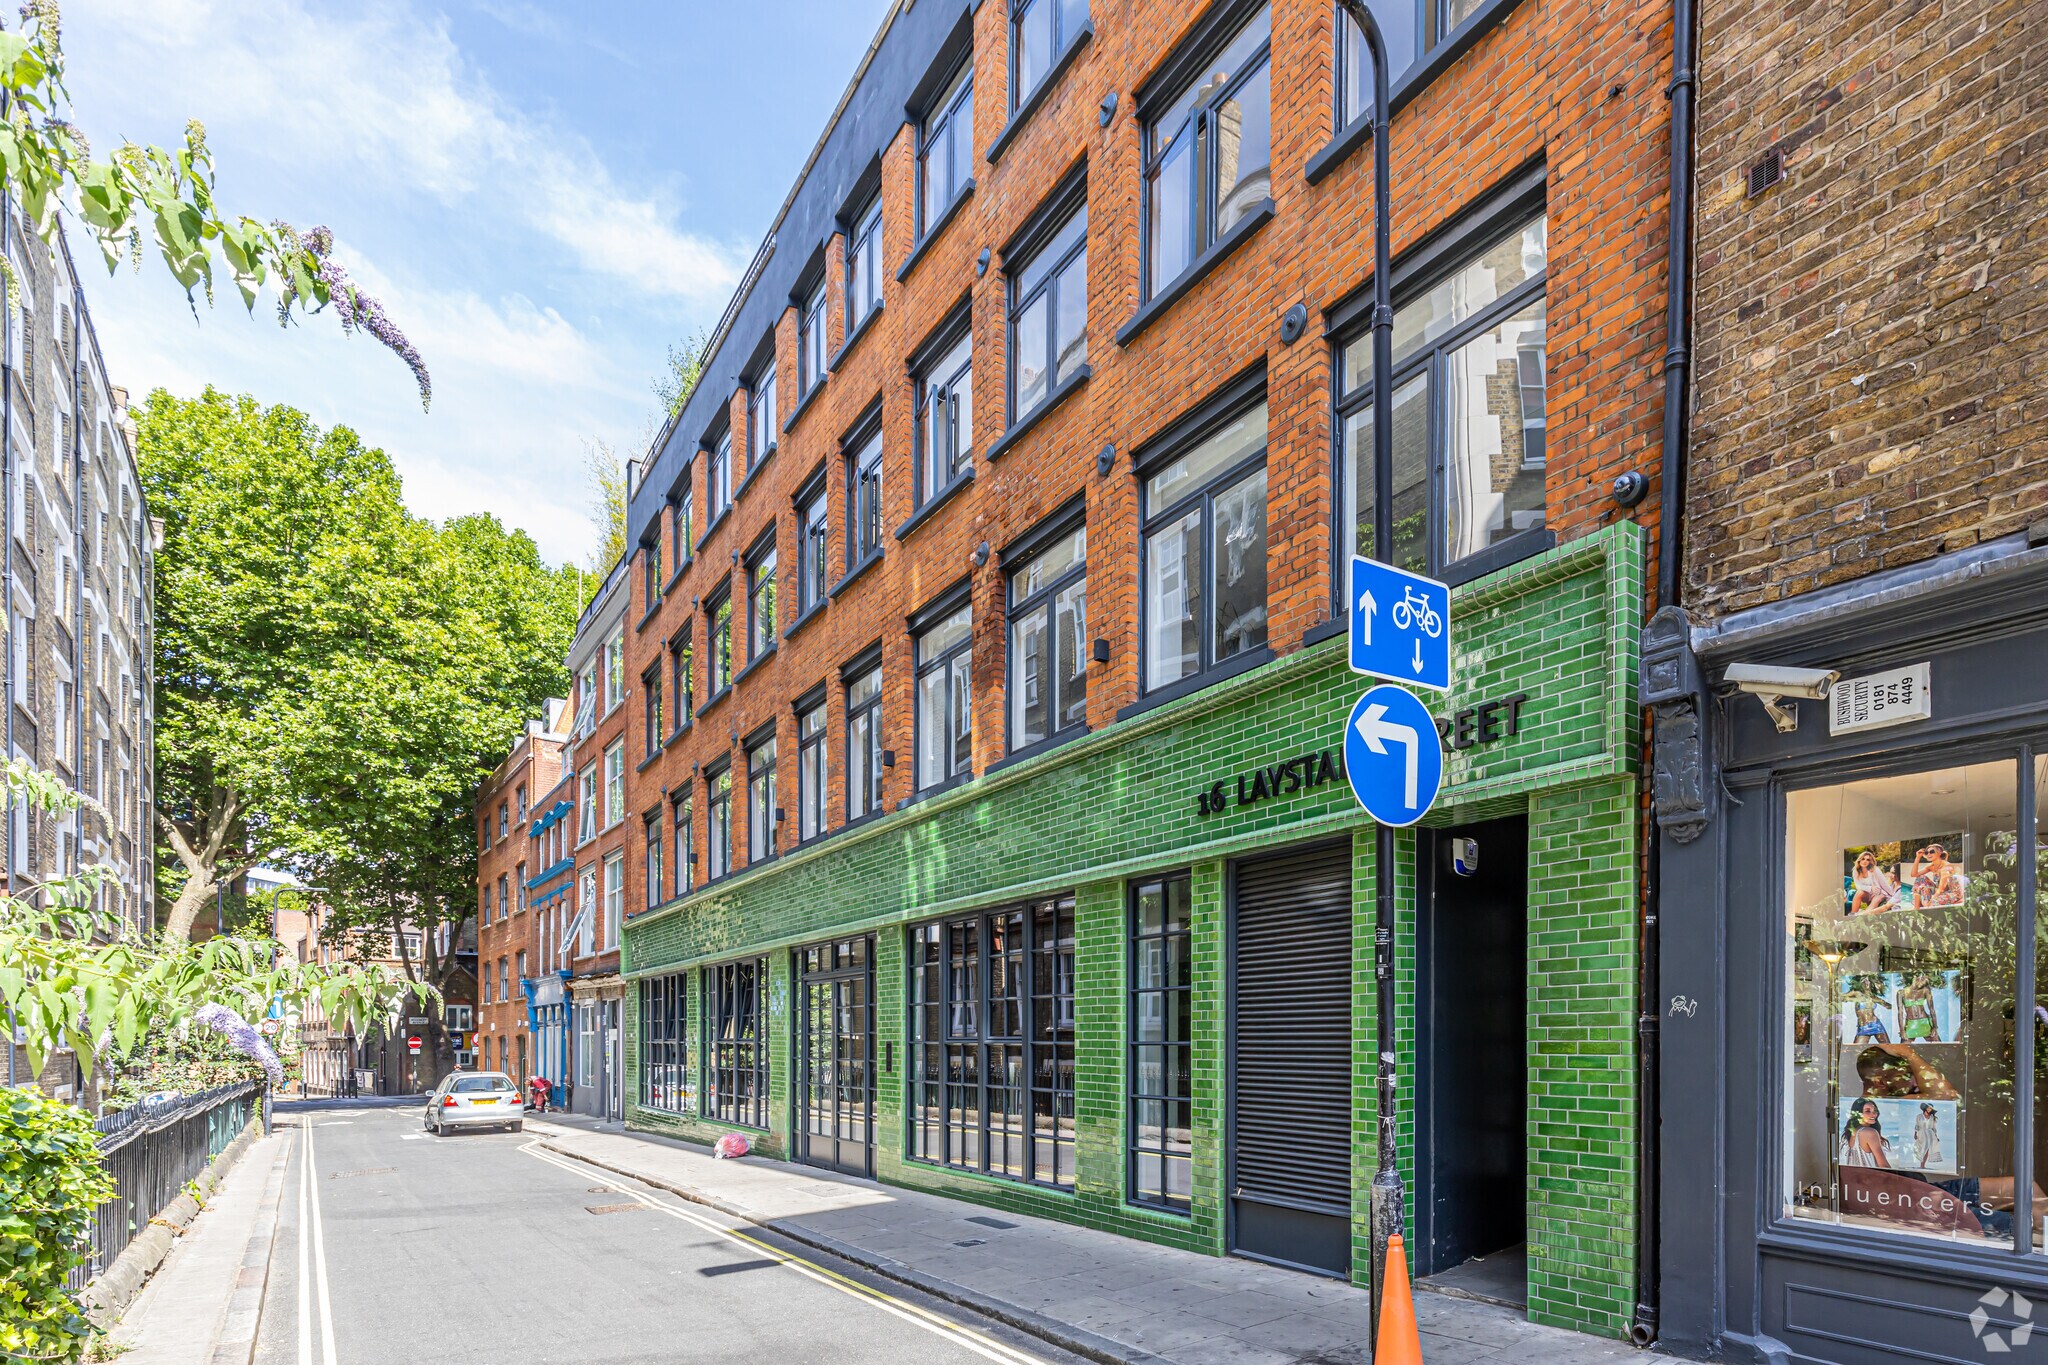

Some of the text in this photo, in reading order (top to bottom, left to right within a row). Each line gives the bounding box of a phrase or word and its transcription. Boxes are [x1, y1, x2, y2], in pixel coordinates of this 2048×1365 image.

[1837, 683, 1851, 726] BUSHWOOD
[1854, 680, 1869, 722] SECURITY
[1873, 684, 1885, 711] 0181
[1887, 683, 1899, 705] 874
[1901, 677, 1913, 705] 4449
[1197, 693, 1528, 817] 16 LAYSTA REET
[1798, 1180, 1995, 1217] Influencers
